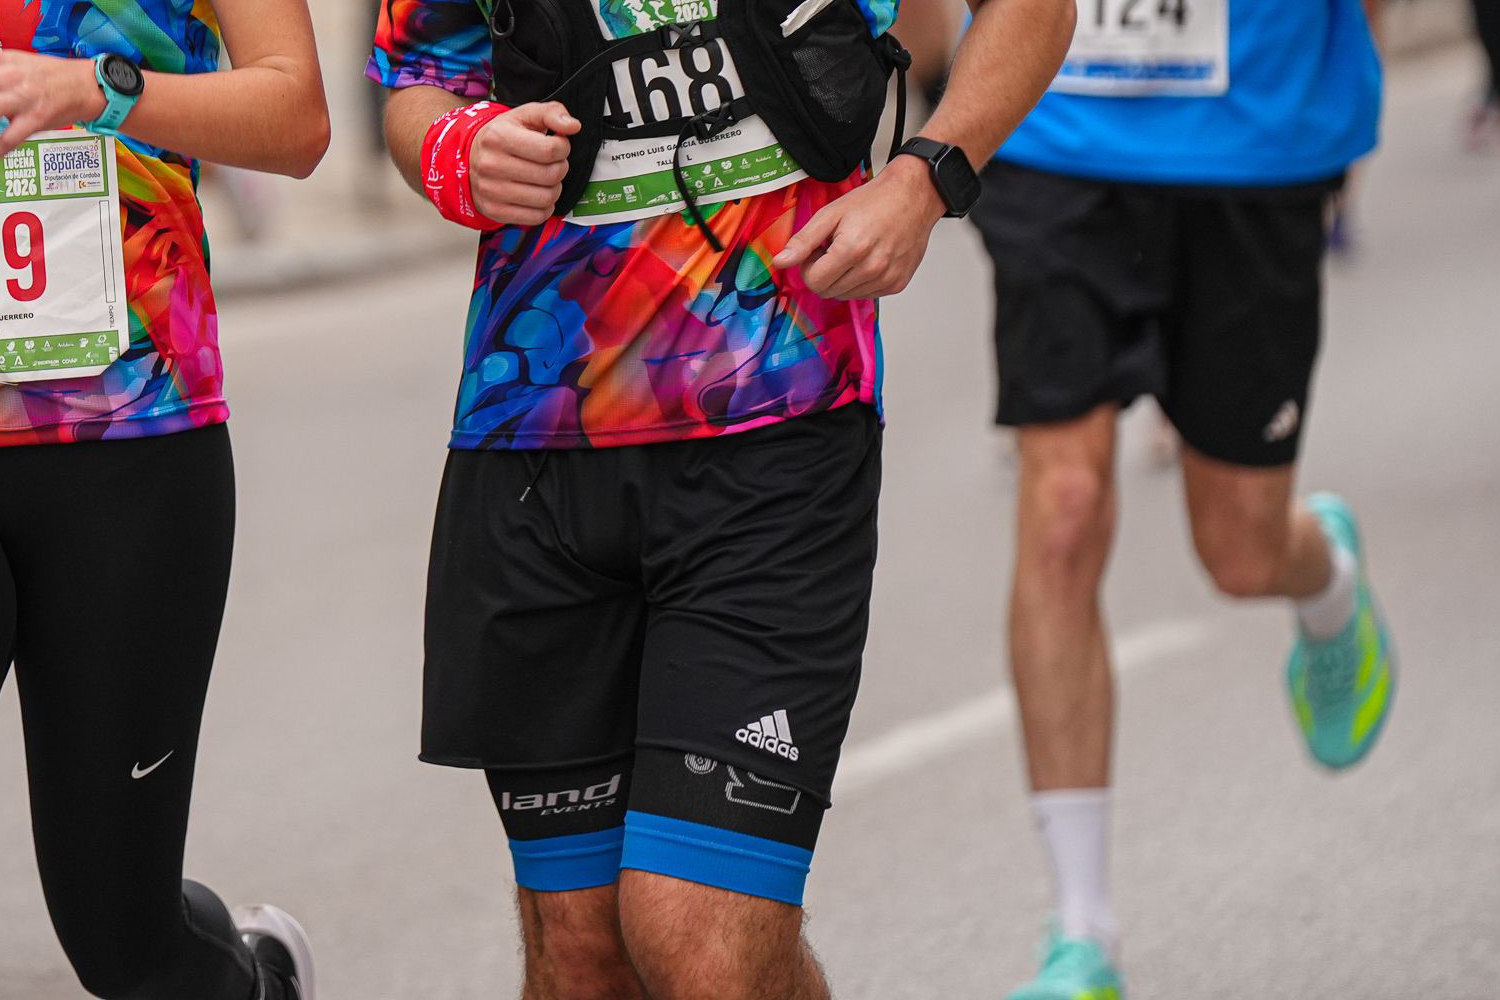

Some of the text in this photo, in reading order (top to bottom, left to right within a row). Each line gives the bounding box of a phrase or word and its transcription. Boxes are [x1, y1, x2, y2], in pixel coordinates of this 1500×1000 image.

[674, 1, 709, 24] 2026
[603, 45, 735, 127] 468
[90, 144, 99, 152] 20
[611, 150, 645, 162] ANTONIO
[647, 146, 665, 156] LUIS
[4, 157, 35, 169] LUCENA
[43, 150, 99, 163] carreras 26
[657, 159, 674, 167] TALL
[44, 158, 100, 174] populares
[44, 173, 71, 182] Diputación
[80, 171, 100, 179] Córdoba
[5, 178, 37, 198] 2026
[735, 728, 799, 761] adidas
[502, 773, 622, 811] land
[540, 797, 617, 816] EVENTS
